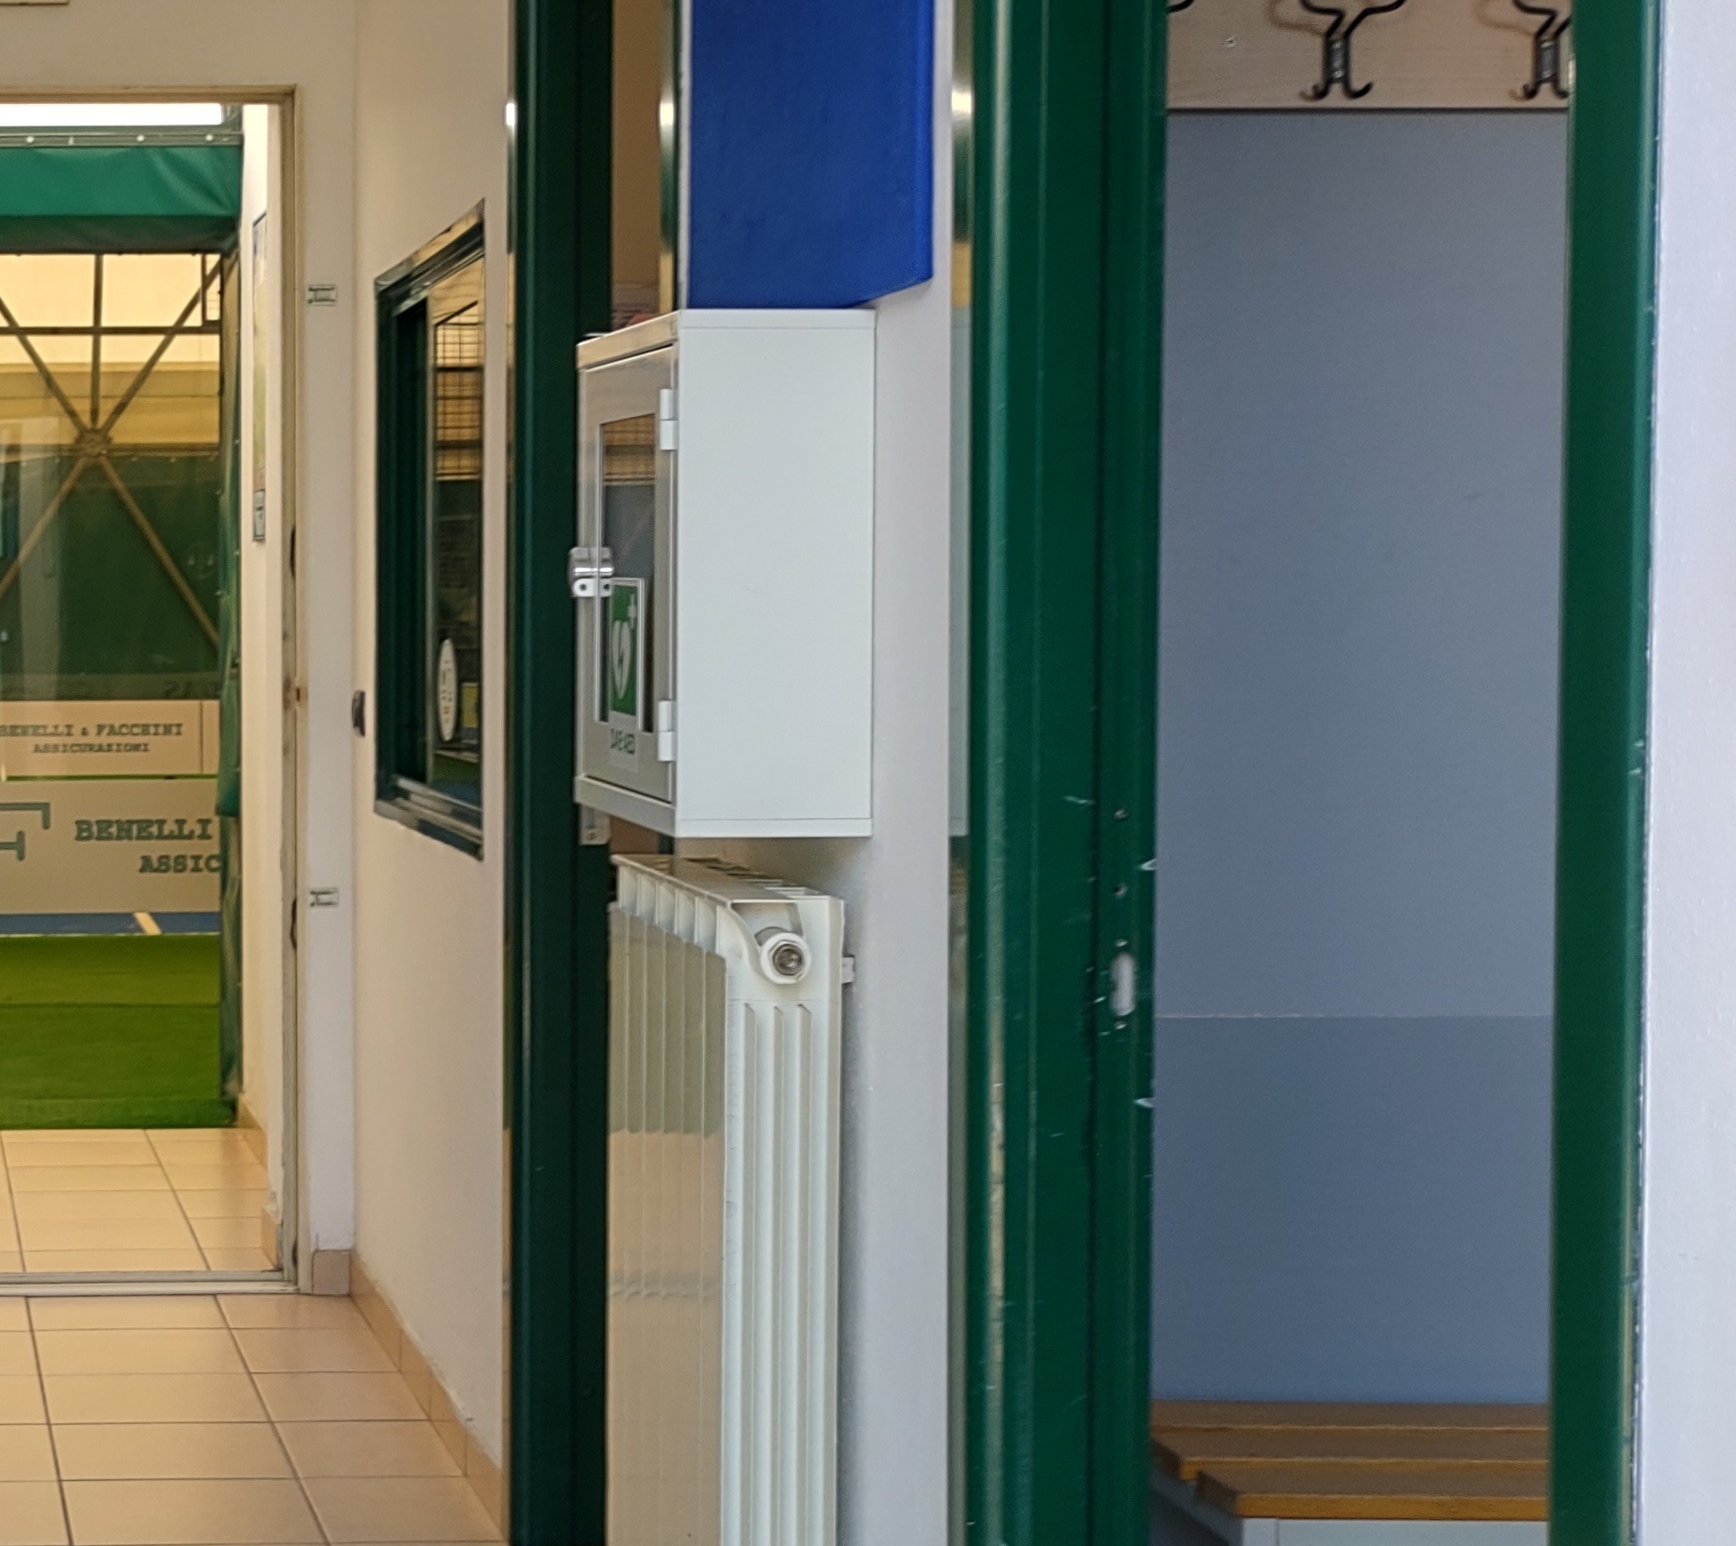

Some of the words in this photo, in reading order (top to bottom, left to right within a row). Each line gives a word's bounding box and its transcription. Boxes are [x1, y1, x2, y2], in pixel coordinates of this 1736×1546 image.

[95, 723, 184, 736] FACCHINI
[33, 742, 150, 754] ASSICURAZIONI
[74, 819, 213, 841] BENELLI
